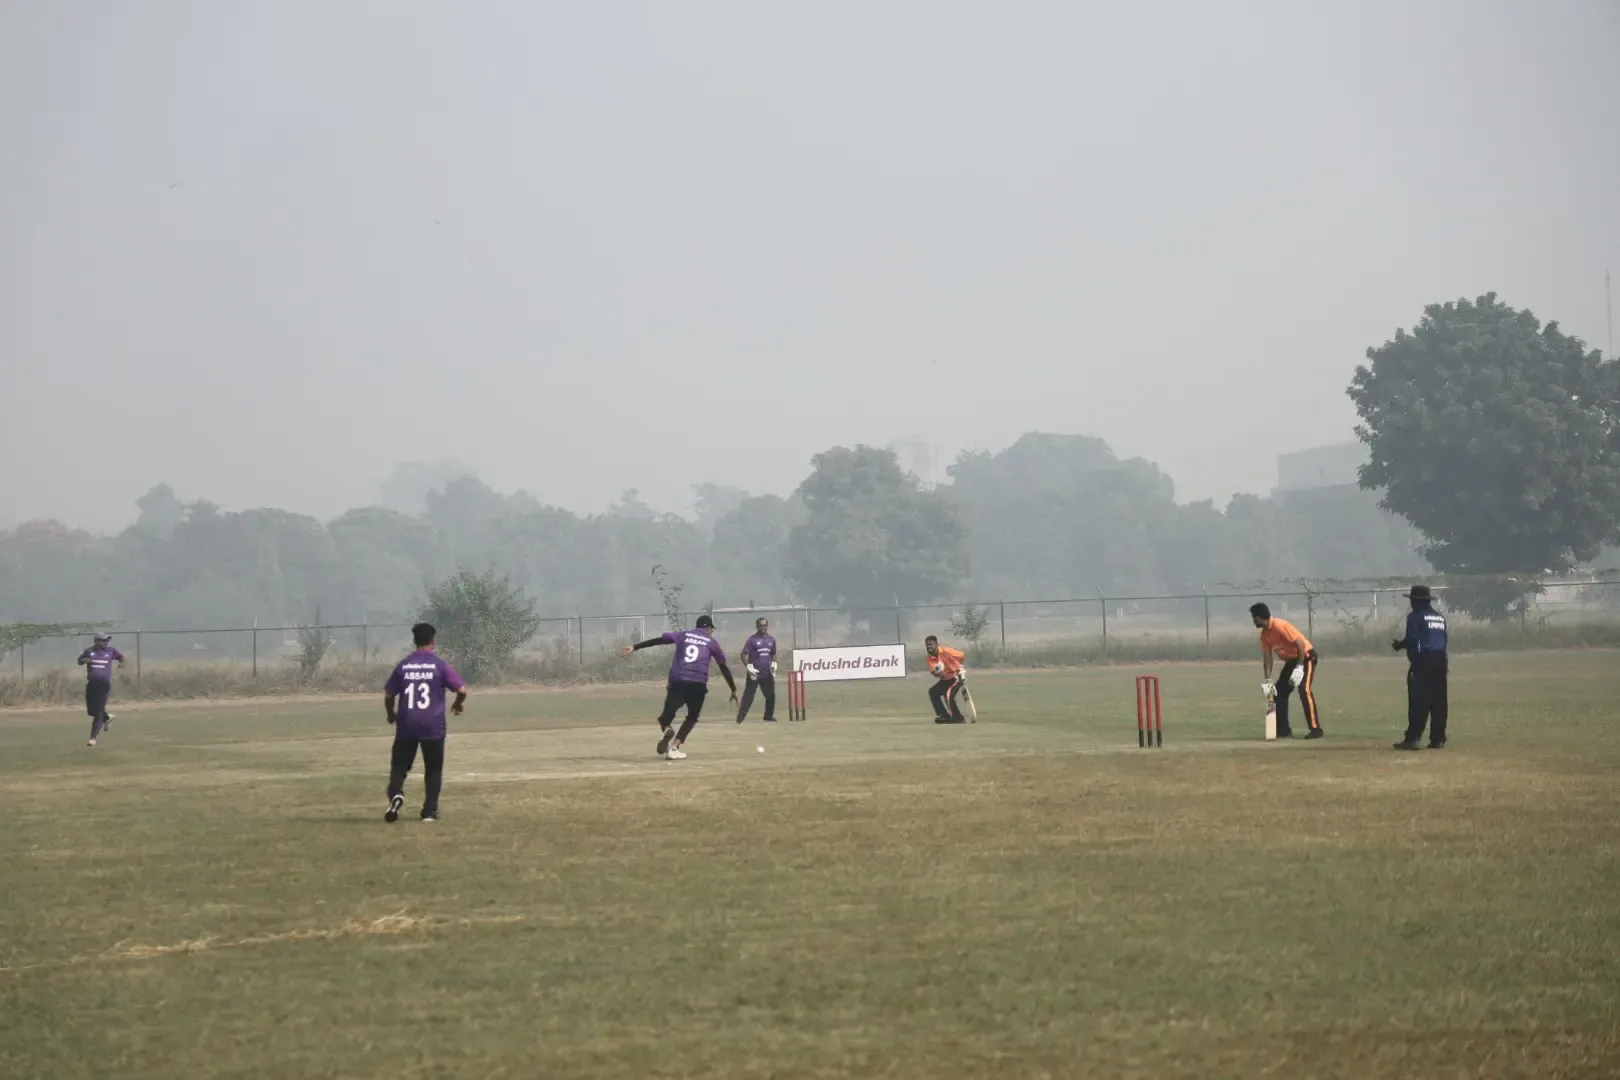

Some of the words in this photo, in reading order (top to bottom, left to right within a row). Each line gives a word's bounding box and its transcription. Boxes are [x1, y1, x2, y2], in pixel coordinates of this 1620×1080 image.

[684, 645, 699, 663] 9
[799, 656, 861, 671] IndusInd
[863, 655, 899, 668] Bank
[404, 672, 433, 680] ASSAM
[404, 682, 430, 709] 13
